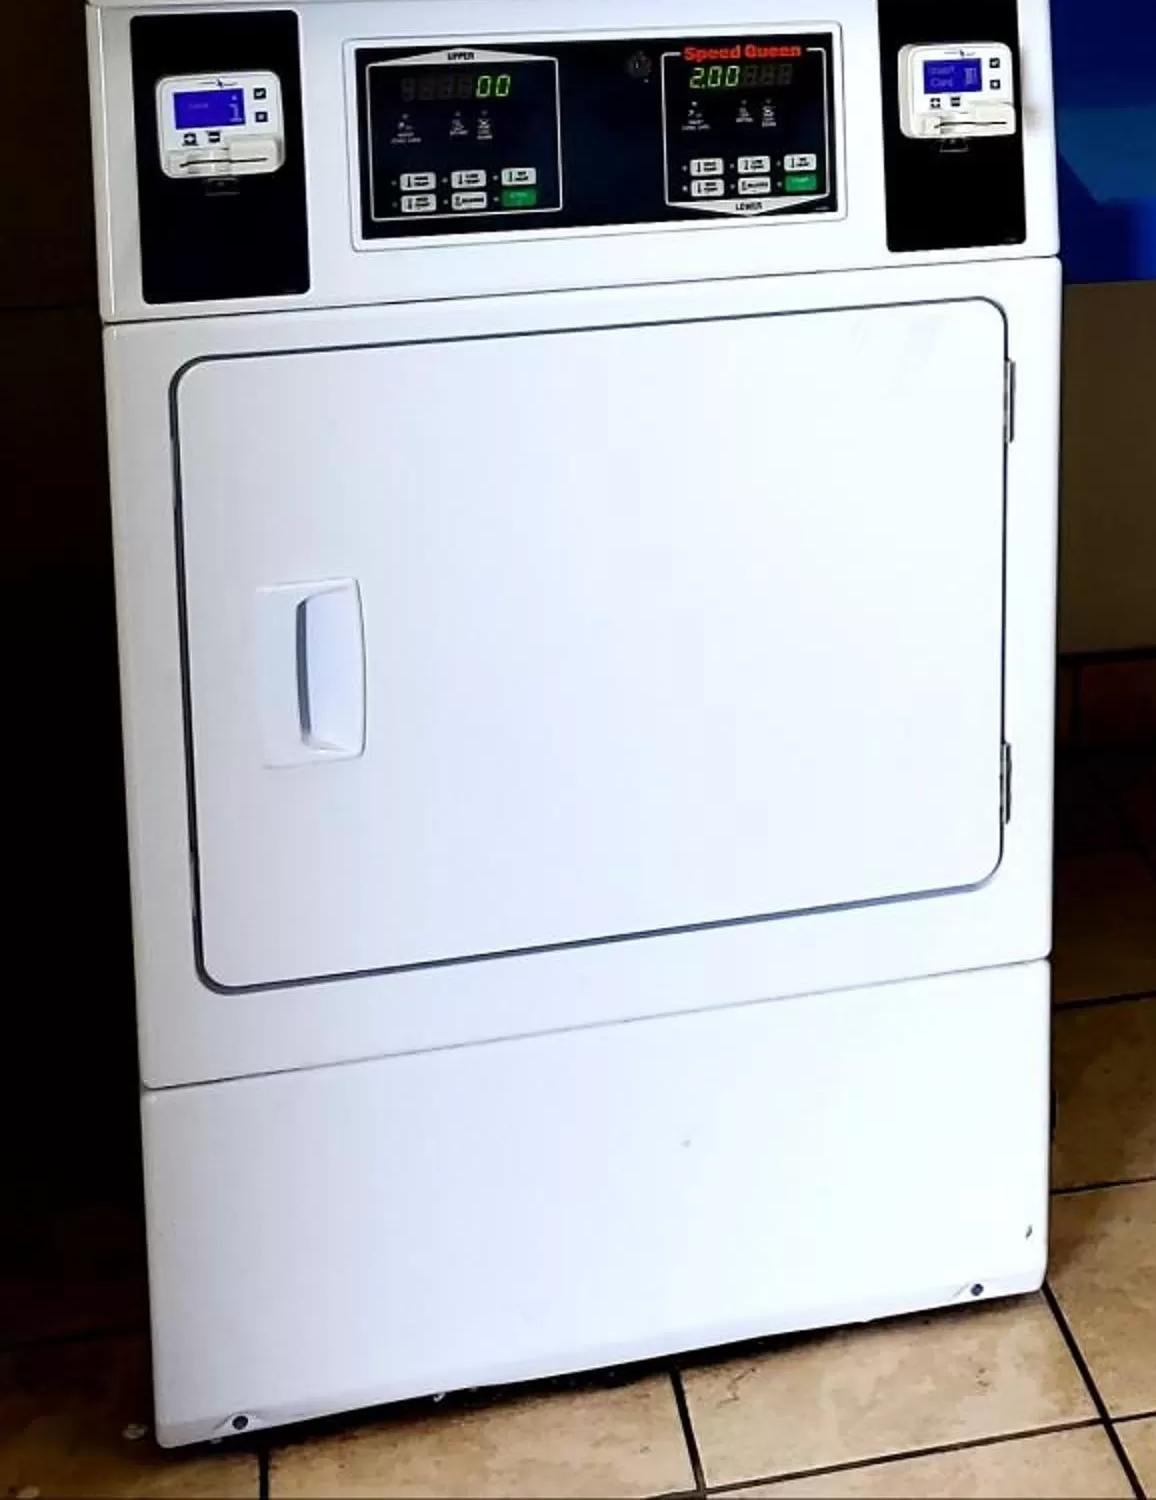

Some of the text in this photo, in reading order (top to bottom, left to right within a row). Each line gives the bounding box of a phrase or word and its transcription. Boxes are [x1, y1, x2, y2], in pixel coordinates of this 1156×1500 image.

[447, 51, 475, 60] UPPER
[684, 43, 801, 62] Speed Queen
[475, 74, 511, 98] 00
[689, 64, 741, 89] 2.00
[735, 201, 763, 211] LOWER
